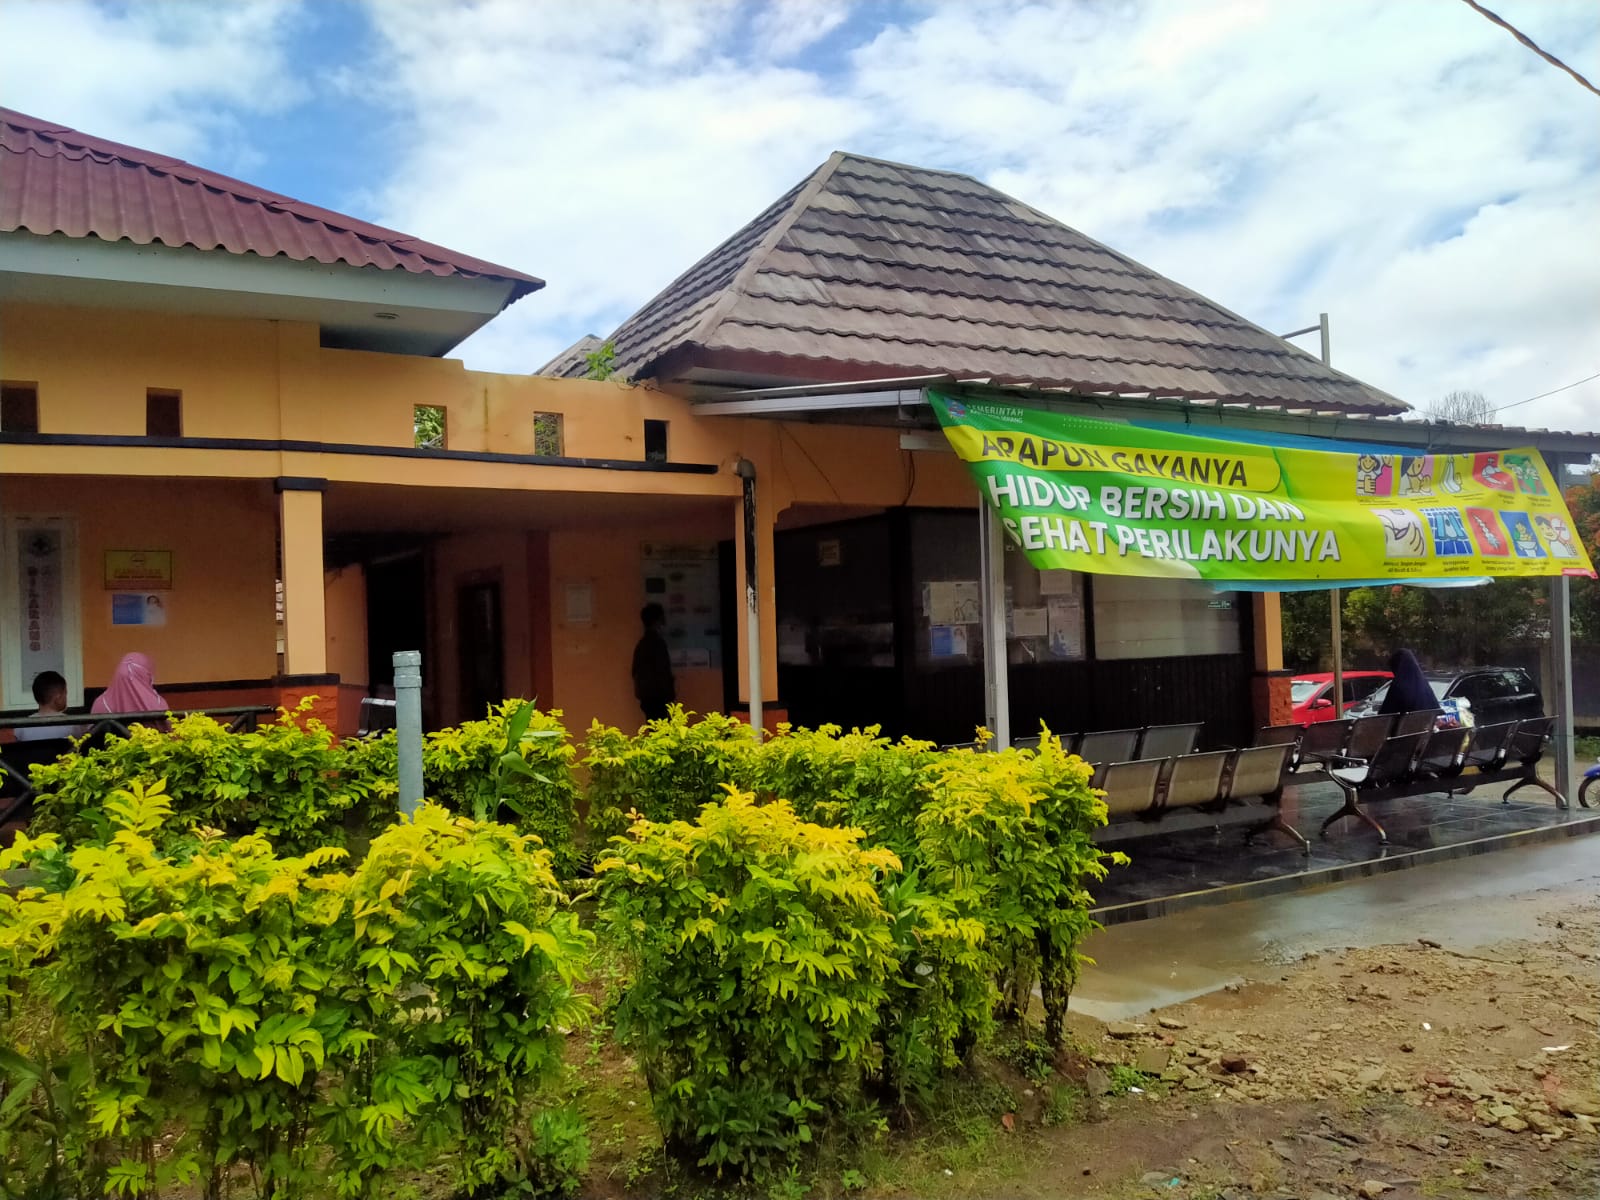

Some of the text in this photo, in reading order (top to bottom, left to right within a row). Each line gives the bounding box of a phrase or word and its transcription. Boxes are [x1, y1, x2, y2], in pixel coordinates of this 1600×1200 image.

[982, 434, 1248, 487] APAPUN GAYANYA
[987, 474, 1306, 521] HIDUP BERSIH DAN
[1003, 516, 1341, 562] SEHAT PERILAKUNYA
